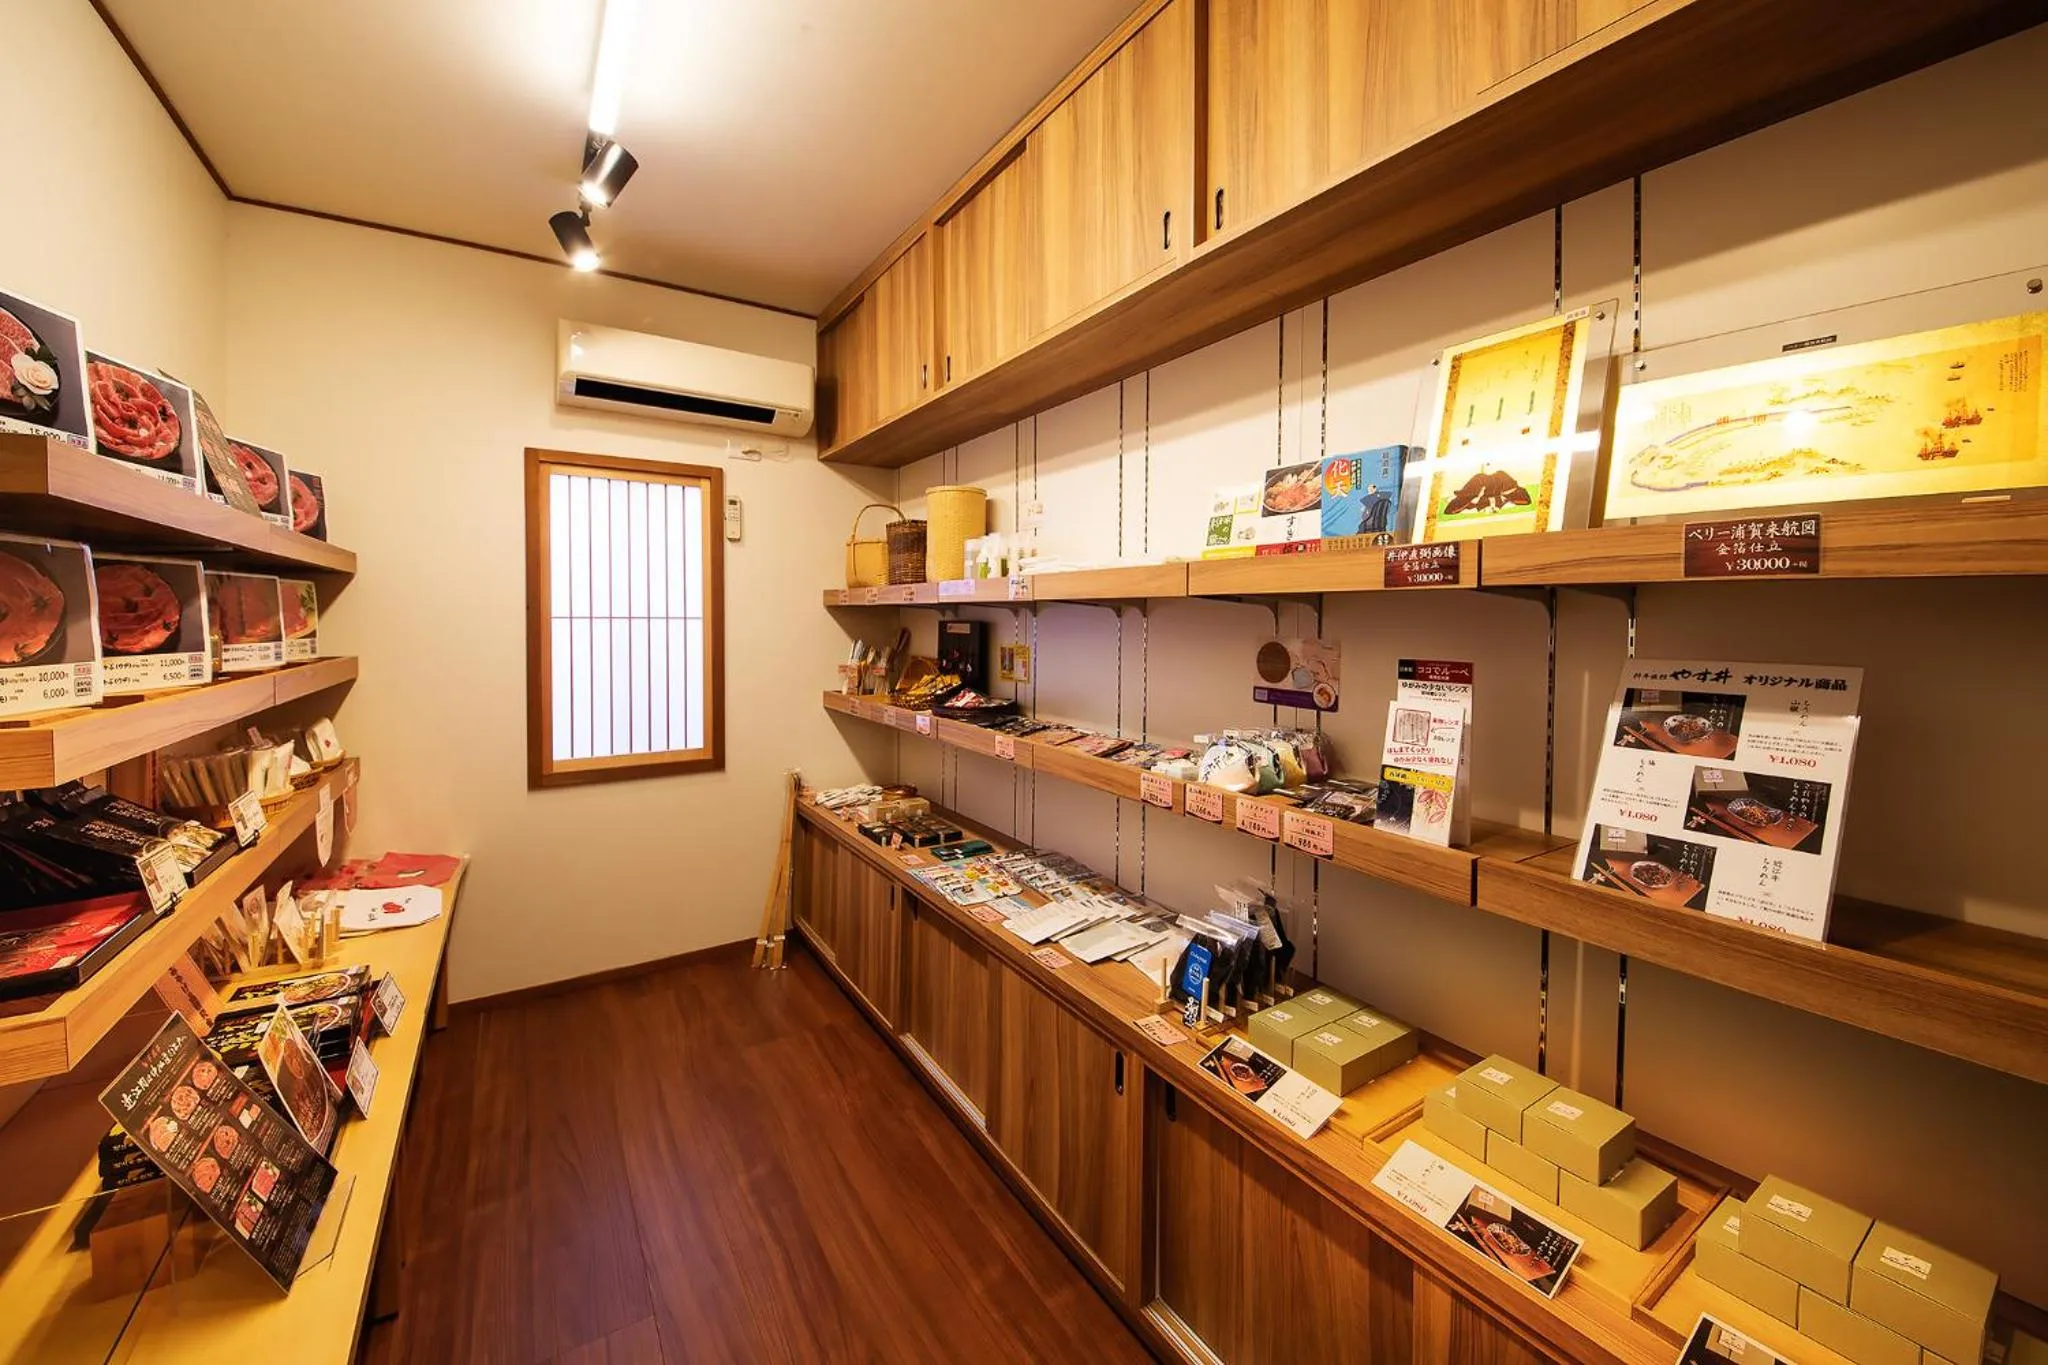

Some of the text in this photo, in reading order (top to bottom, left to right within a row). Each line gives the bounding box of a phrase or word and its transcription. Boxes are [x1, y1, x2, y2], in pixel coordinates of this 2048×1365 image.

[1688, 519, 1816, 540] ペリー浦賀来航図
[1715, 540, 1783, 556] 金箔仕立
[1417, 666, 1470, 677] ココでルーペ
[1743, 674, 1847, 692] オリジナル商品
[1769, 755, 1817, 768] ¥1,080
[1619, 808, 1658, 822] ¥1,080
